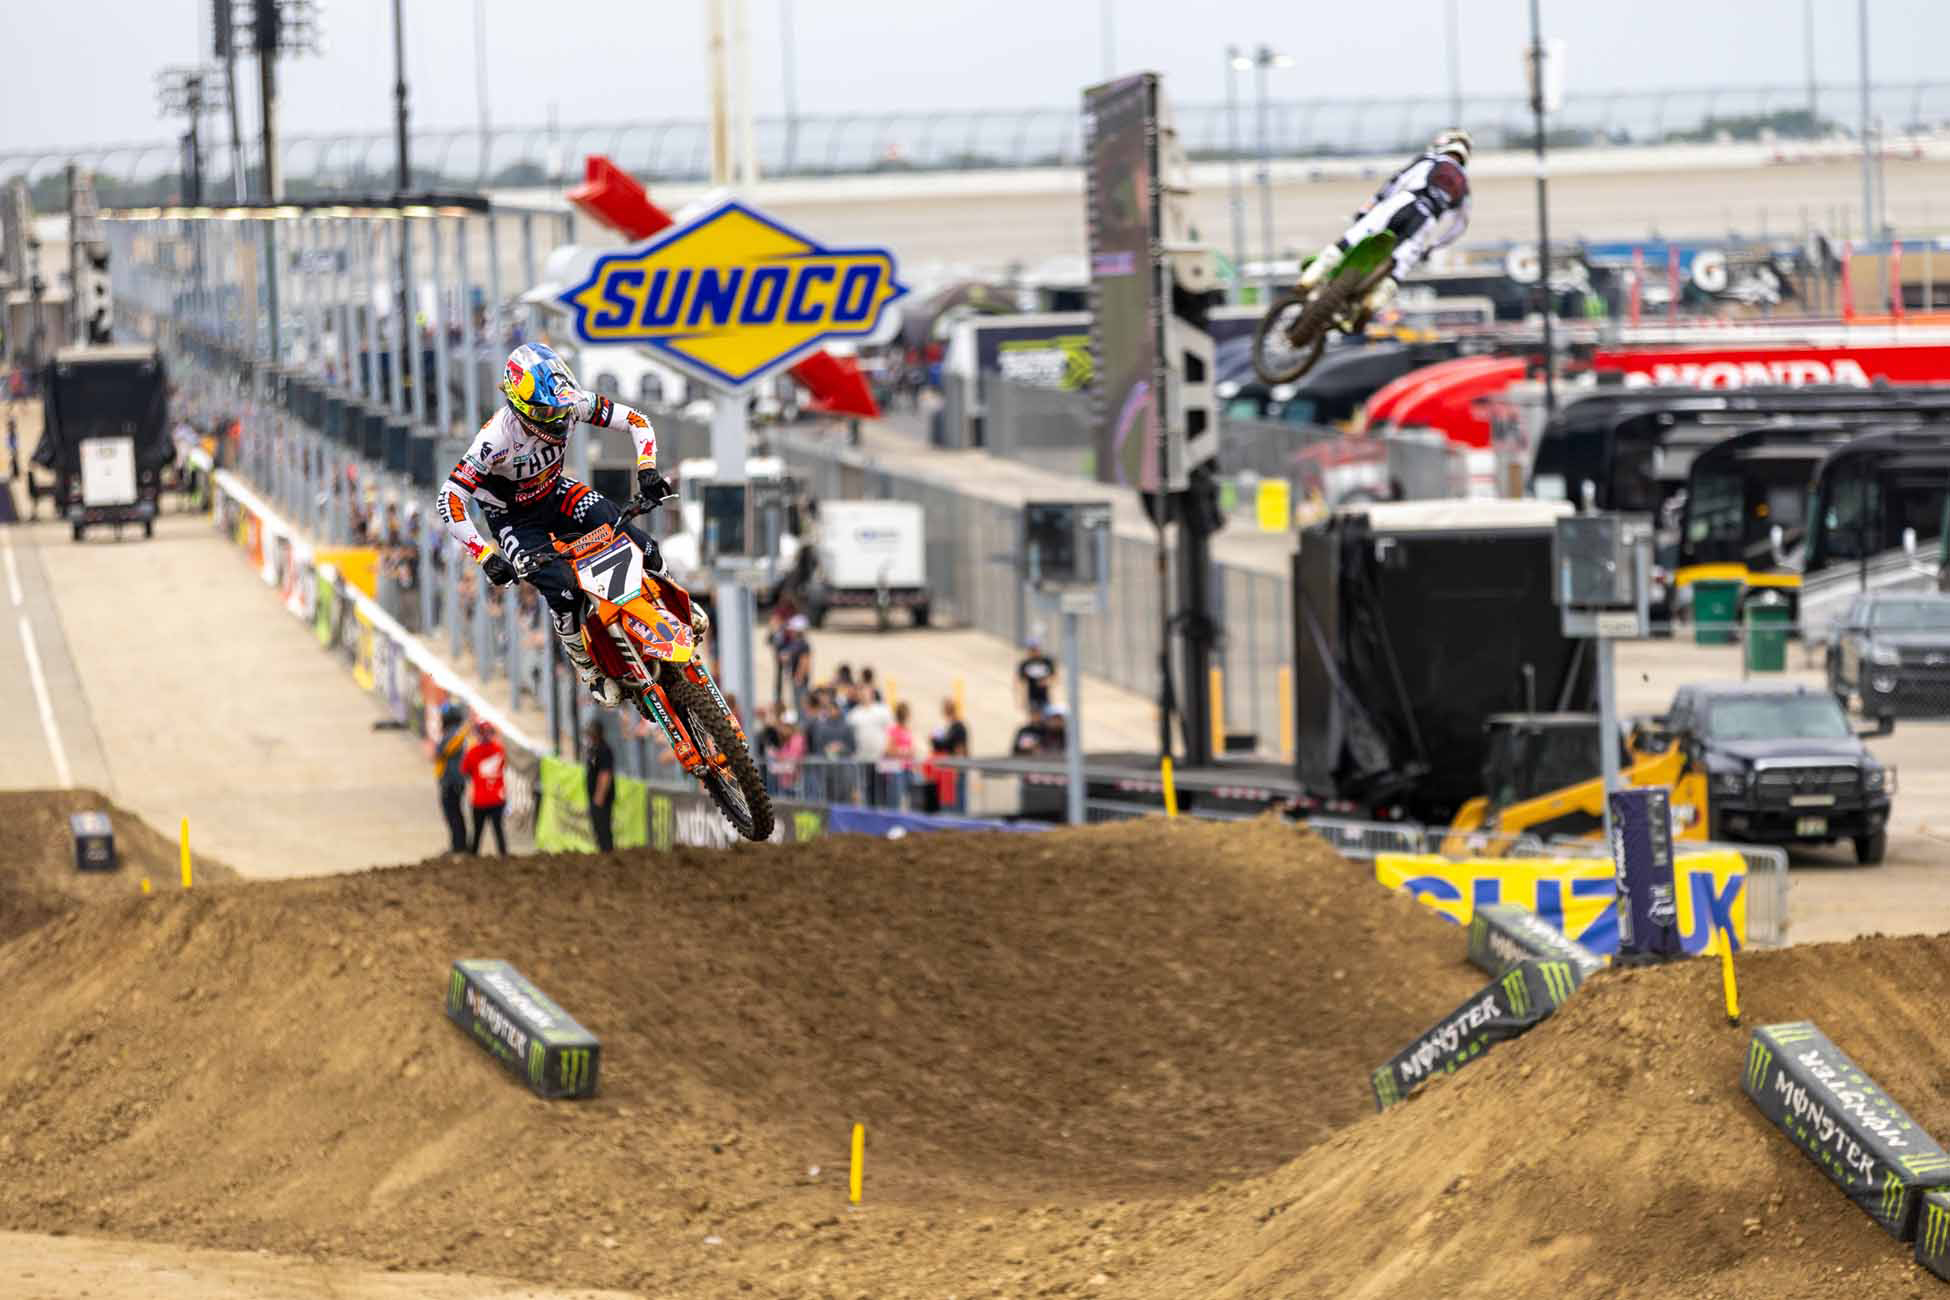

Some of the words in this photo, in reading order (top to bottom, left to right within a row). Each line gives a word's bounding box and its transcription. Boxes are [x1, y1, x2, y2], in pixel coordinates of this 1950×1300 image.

[593, 265, 883, 329] SUNOCO
[436, 491, 450, 523] THOR
[590, 545, 633, 601] 7
[1400, 994, 1501, 1081] MONSTER
[1774, 1069, 1876, 1186] MONSTER
